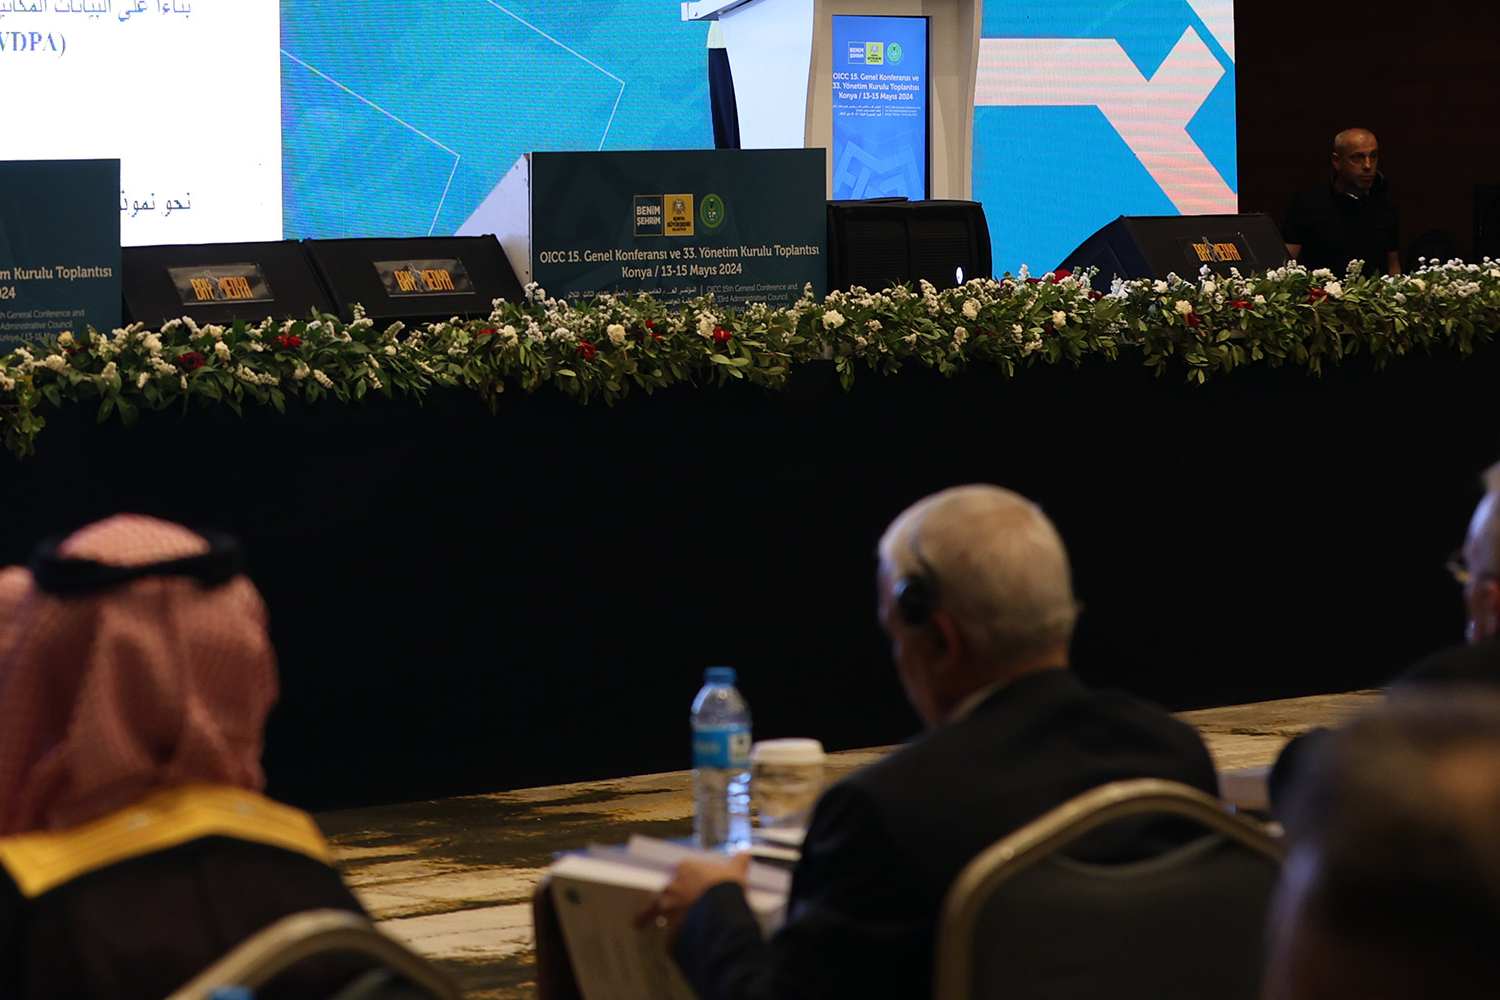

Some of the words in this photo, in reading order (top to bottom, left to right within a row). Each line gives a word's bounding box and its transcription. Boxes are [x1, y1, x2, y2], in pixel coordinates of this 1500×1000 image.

[833, 72, 849, 80] OICC
[540, 250, 565, 263] OICC
[568, 250, 582, 262] 15.
[584, 250, 612, 262] Genel
[615, 248, 668, 260] Konferansı
[670, 250, 680, 259] ve
[683, 247, 698, 259] 33.
[699, 246, 738, 258] Yönetim
[740, 246, 772, 257] Kurulu
[774, 244, 820, 258] Toplantısı
[14, 266, 54, 280] Kurulu
[56, 265, 112, 281] Toplantısı
[622, 266, 652, 280] Konya
[661, 264, 688, 277] 13-15
[690, 264, 718, 278] Mayıs
[720, 262, 742, 275] 2024
